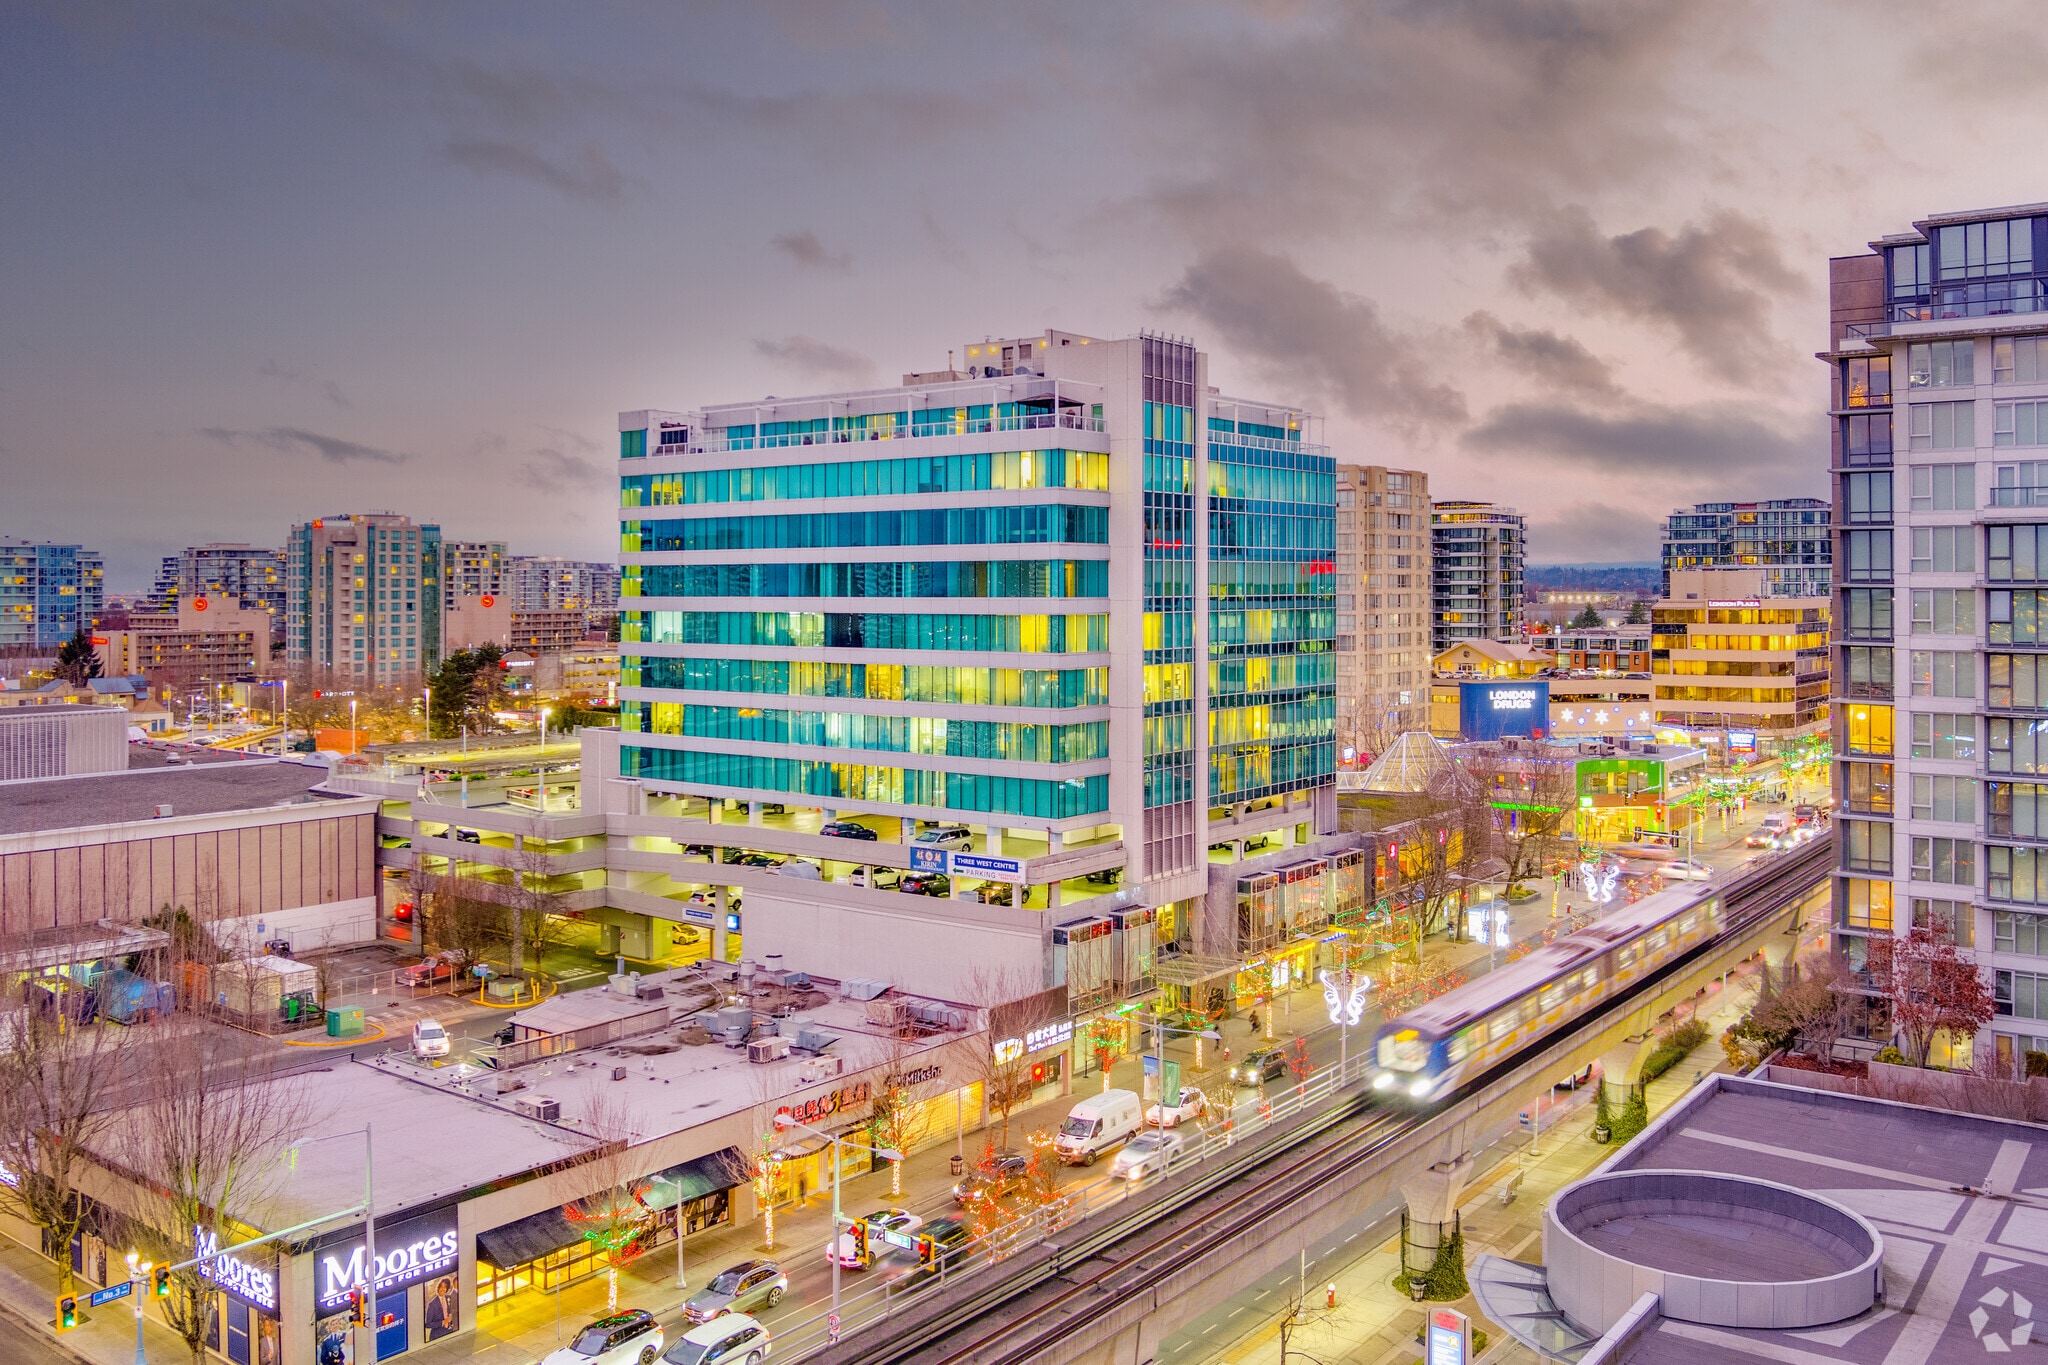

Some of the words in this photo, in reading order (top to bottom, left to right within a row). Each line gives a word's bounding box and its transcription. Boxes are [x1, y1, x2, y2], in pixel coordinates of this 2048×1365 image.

[1489, 690, 1536, 700] LONDON
[1493, 699, 1532, 710] DRUGS
[920, 860, 937, 869] KIRIN
[957, 857, 976, 866] THREE
[976, 859, 993, 868] WEST
[993, 862, 1016, 871] CENTRE
[966, 868, 996, 879] PARKING
[194, 1225, 273, 1298] Moores
[322, 1230, 458, 1298] Moores
[397, 1269, 421, 1283] FOR
[425, 1258, 451, 1274] MEN
[102, 1288, 120, 1300] No.3
